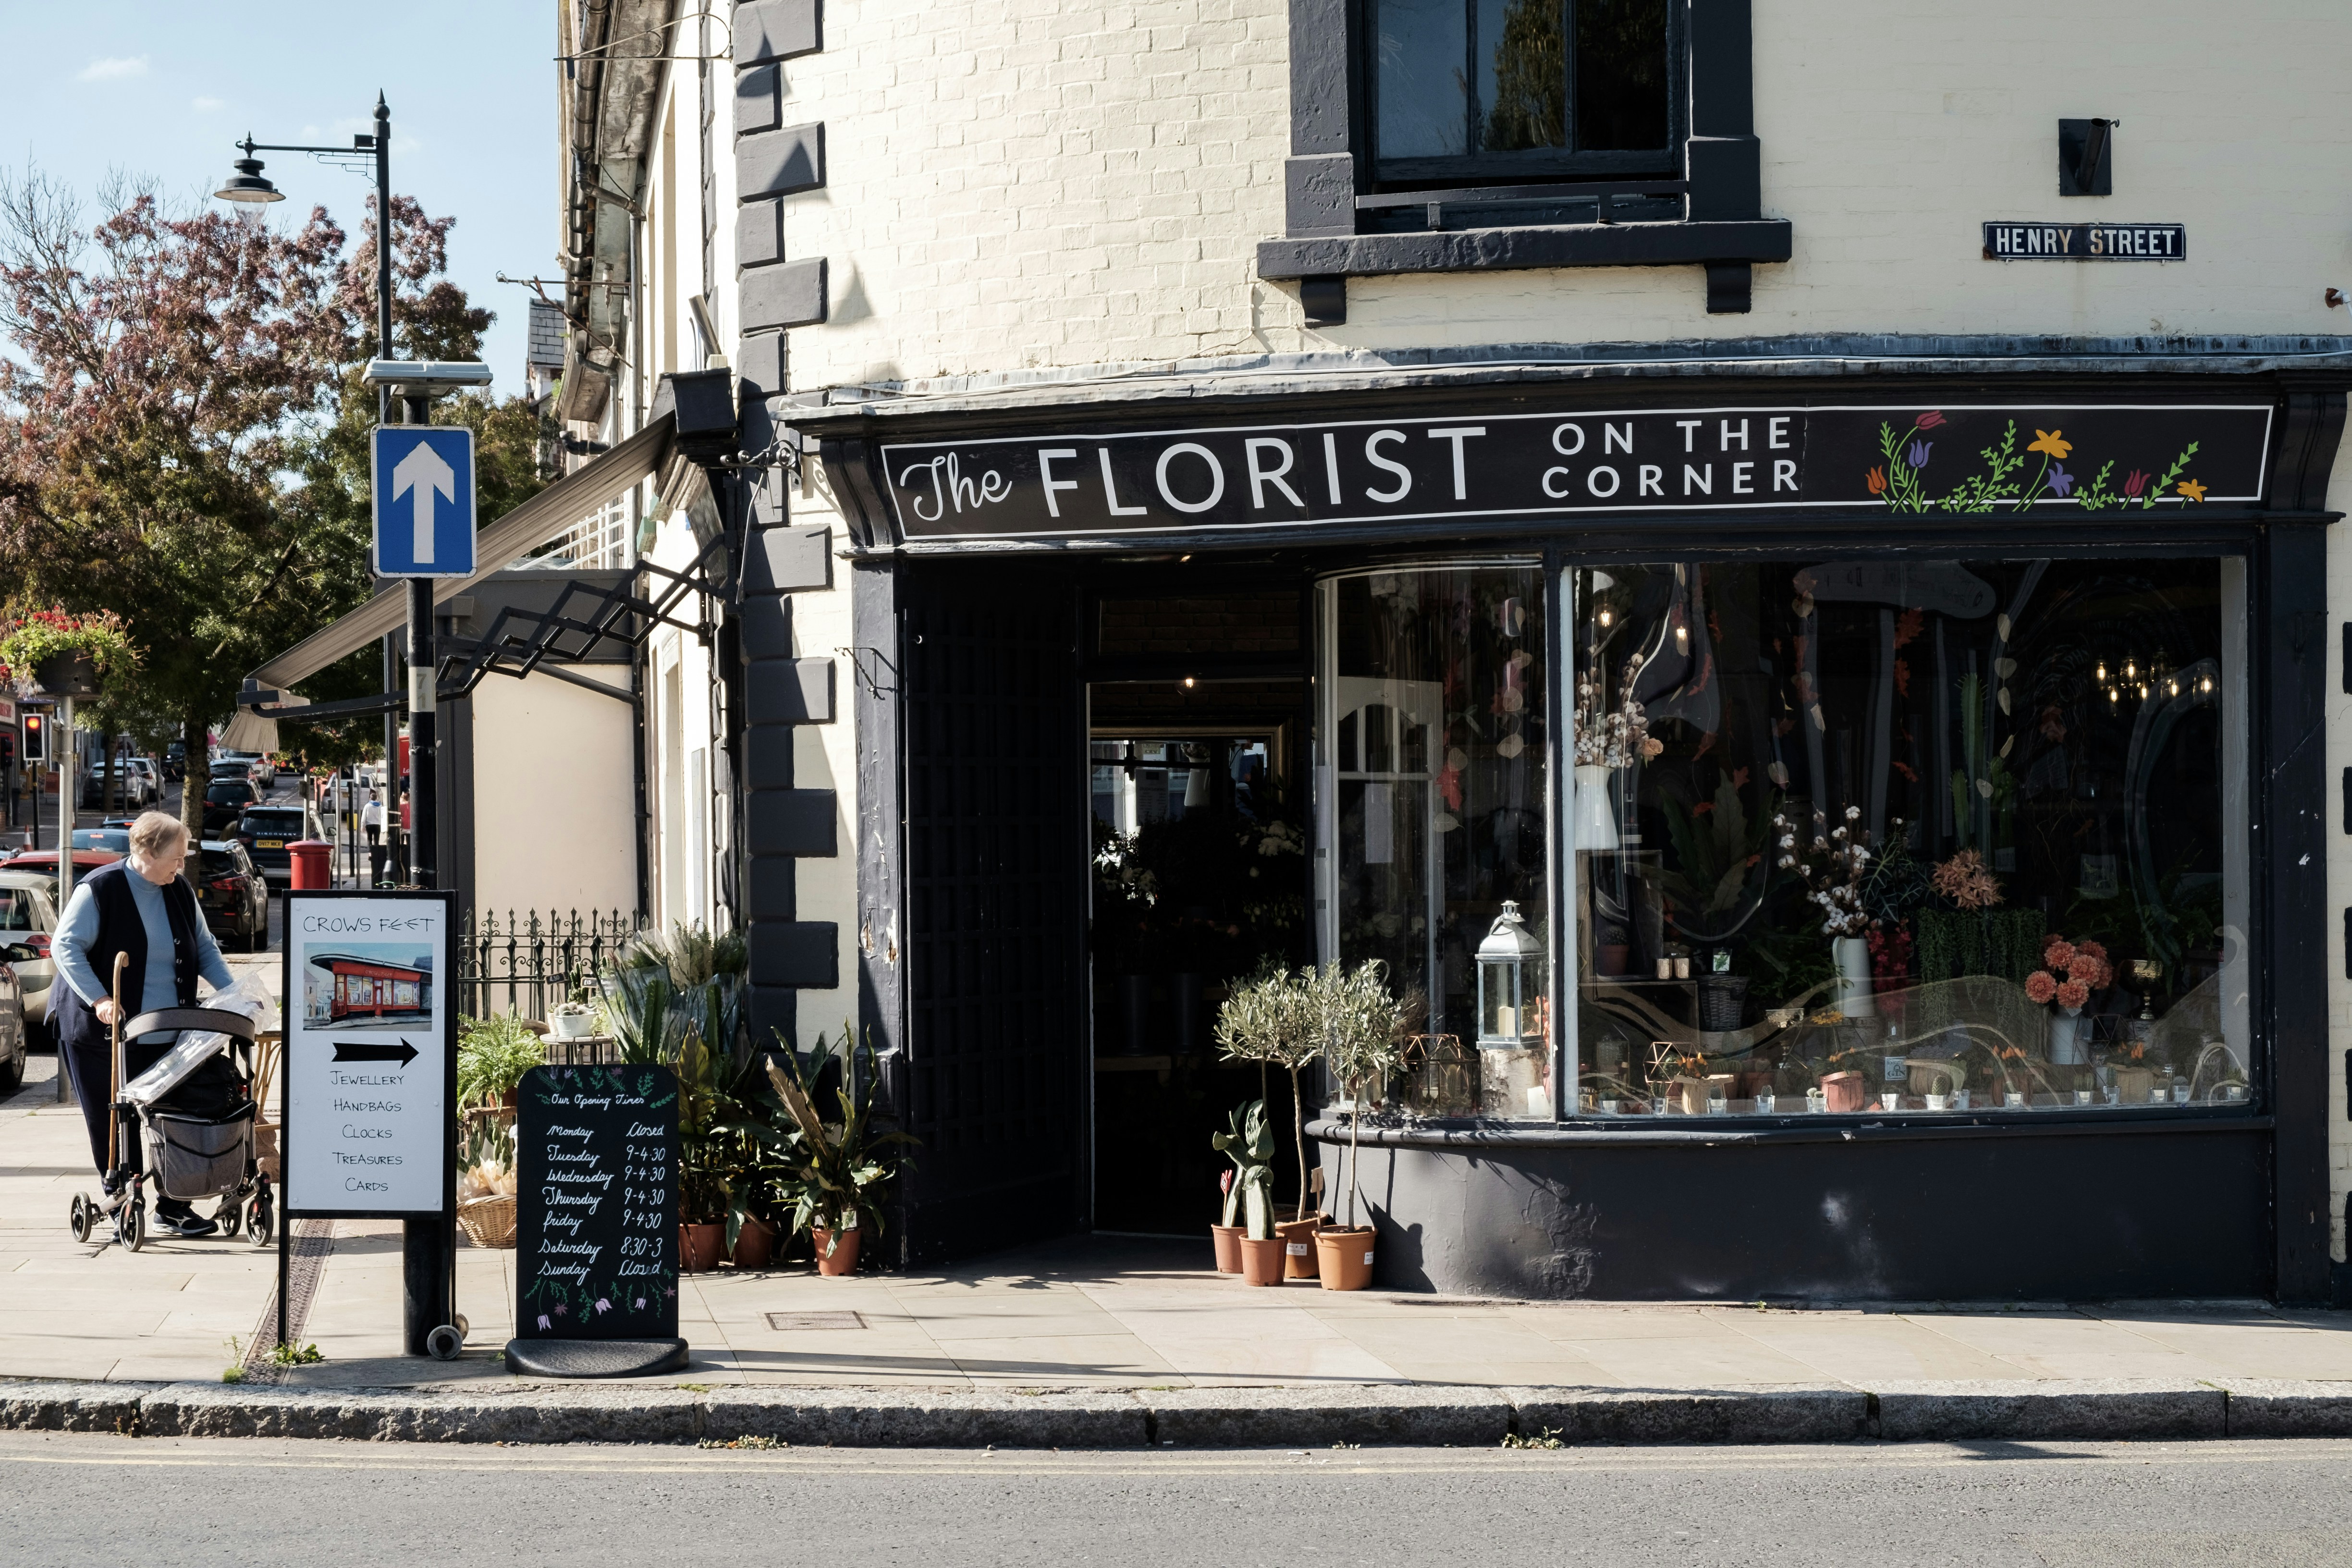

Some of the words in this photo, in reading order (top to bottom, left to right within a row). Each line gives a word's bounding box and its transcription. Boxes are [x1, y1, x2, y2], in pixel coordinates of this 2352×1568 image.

[1997, 228, 2072, 253] HENRY
[2090, 229, 2175, 254] STREET
[1553, 422, 1632, 455] ON
[1676, 416, 1790, 452] THE
[900, 451, 1012, 521] The
[1038, 426, 1486, 517] FLORIST
[1542, 460, 1799, 498] CORNER
[303, 916, 371, 932] CROWS
[379, 918, 435, 931] FEET
[330, 1071, 404, 1086] JEWELLERY
[334, 1098, 402, 1112] HANDBAGS
[551, 1093, 569, 1104] Our
[574, 1094, 611, 1111] Opening
[342, 1125, 392, 1138] CLOCKS
[626, 1122, 664, 1137] Closed
[332, 1152, 403, 1165] TREASURES
[547, 1144, 600, 1168] Tuesday
[345, 1177, 388, 1191] CARDS
[547, 1169, 614, 1190] Wednesday
[542, 1187, 602, 1214] Thursday
[538, 1238, 602, 1263] Saturday
[537, 1260, 591, 1286] Sunday
[618, 1260, 662, 1276] Closed
